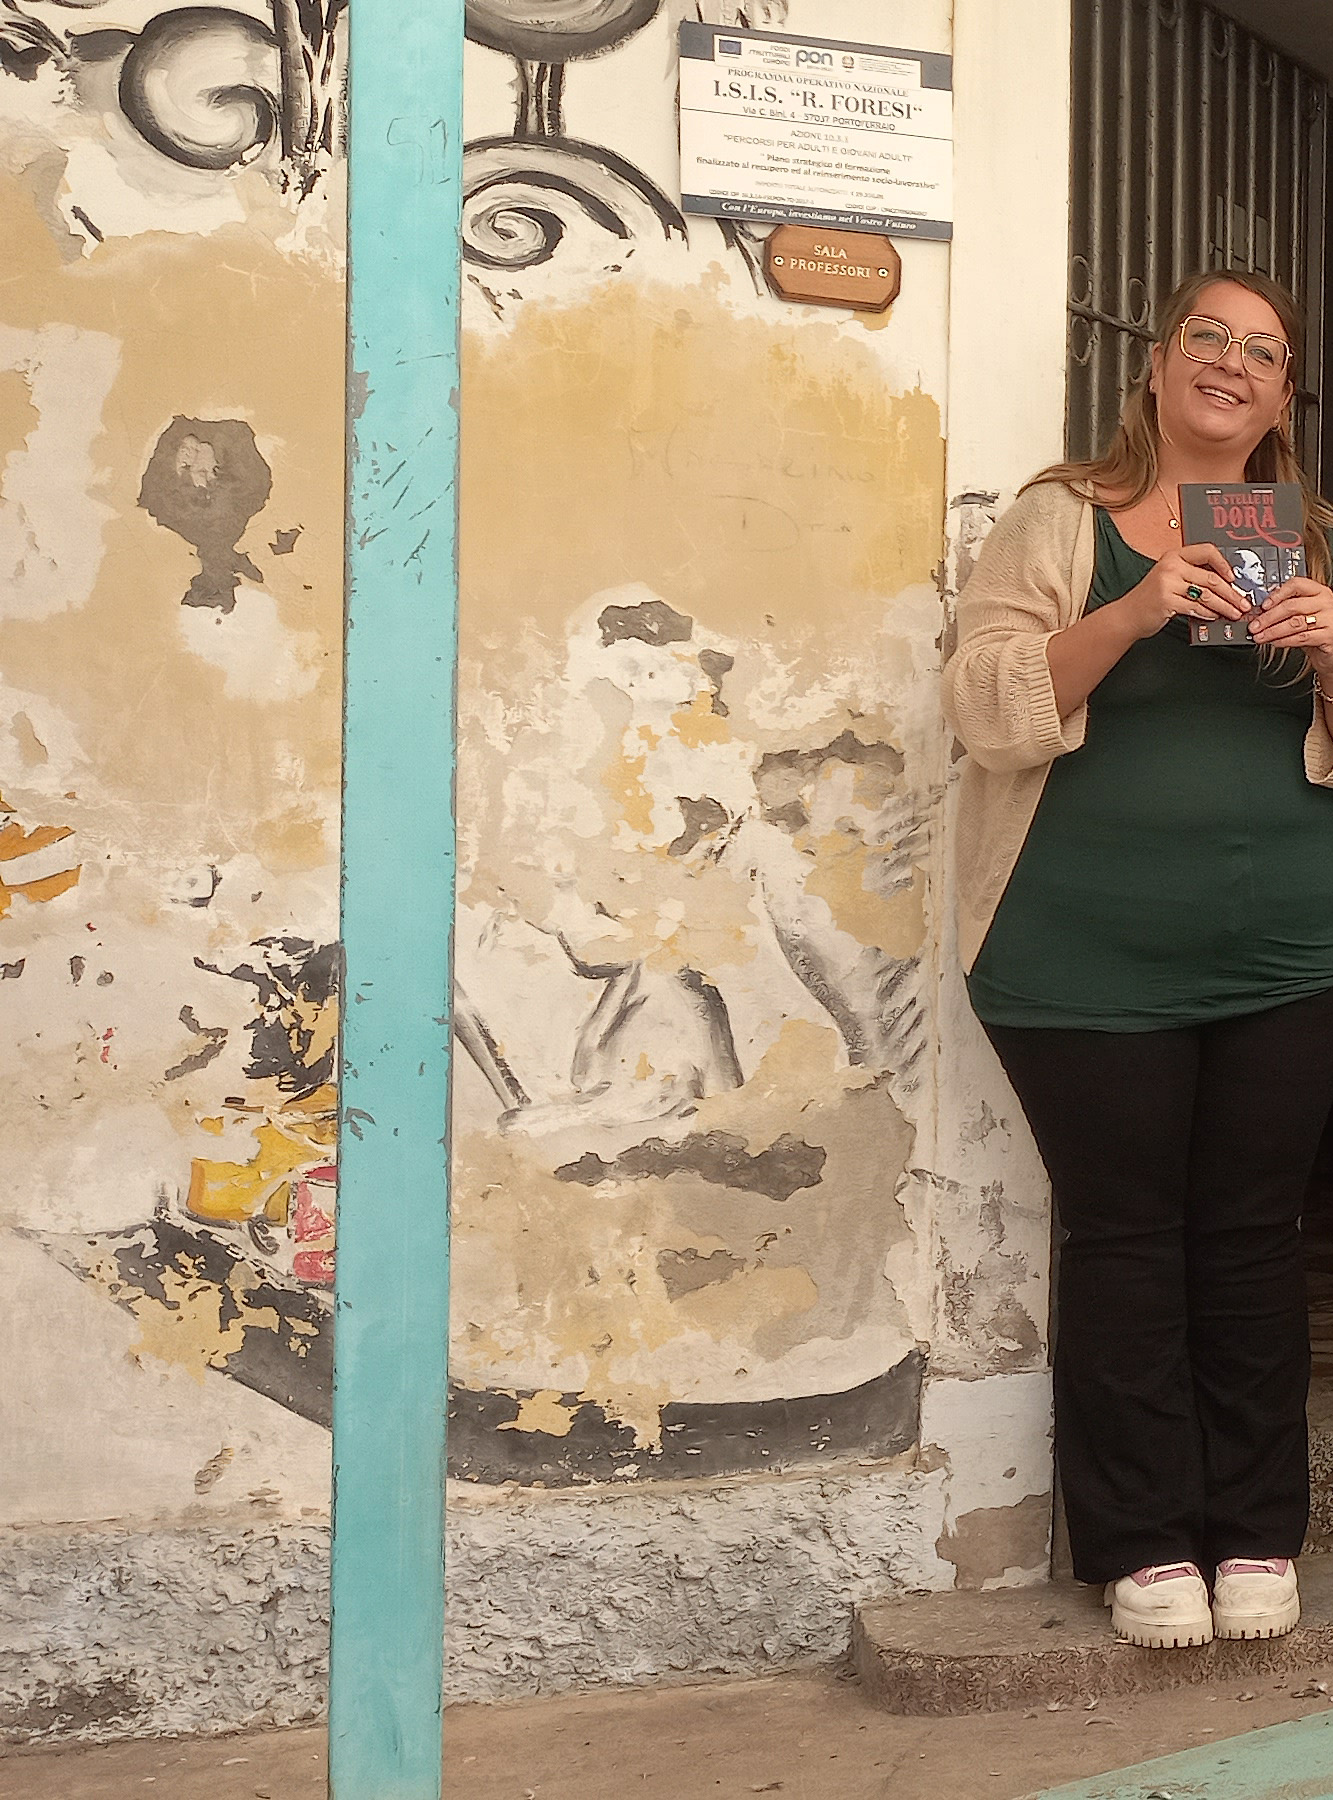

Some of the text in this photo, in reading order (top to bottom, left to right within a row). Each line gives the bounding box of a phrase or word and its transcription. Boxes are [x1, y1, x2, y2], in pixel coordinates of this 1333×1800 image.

[796, 49, 833, 67] pon
[714, 80, 782, 104] I.S.I.S.
[728, 68, 793, 83] PROGRAMMA
[796, 76, 851, 89] OPERATIVO
[854, 84, 908, 97] NAZIONALE
[742, 106, 756, 115] Via
[804, 113, 829, 123] 57037
[832, 116, 896, 131] PORTOFERRAIO
[791, 130, 822, 140] AZIONE
[777, 140, 795, 149] PER
[798, 143, 830, 152] ADULTI
[832, 146, 838, 154] E
[840, 148, 877, 158] GIOVANI
[696, 156, 740, 168] finalizzato
[752, 164, 788, 175] recupero
[804, 168, 811, 176] al
[767, 154, 790, 163] Piano
[792, 157, 833, 169] strategico
[844, 163, 890, 175] formazione
[722, 202, 740, 212] Con
[789, 209, 836, 221] investiamo
[855, 215, 882, 226] Vostro
[885, 218, 916, 229] Futuro
[814, 244, 847, 259] SALA
[790, 258, 870, 278] PROFESSORI
[1208, 493, 1274, 504] LE STELLE DI
[1212, 505, 1277, 529] DORA
